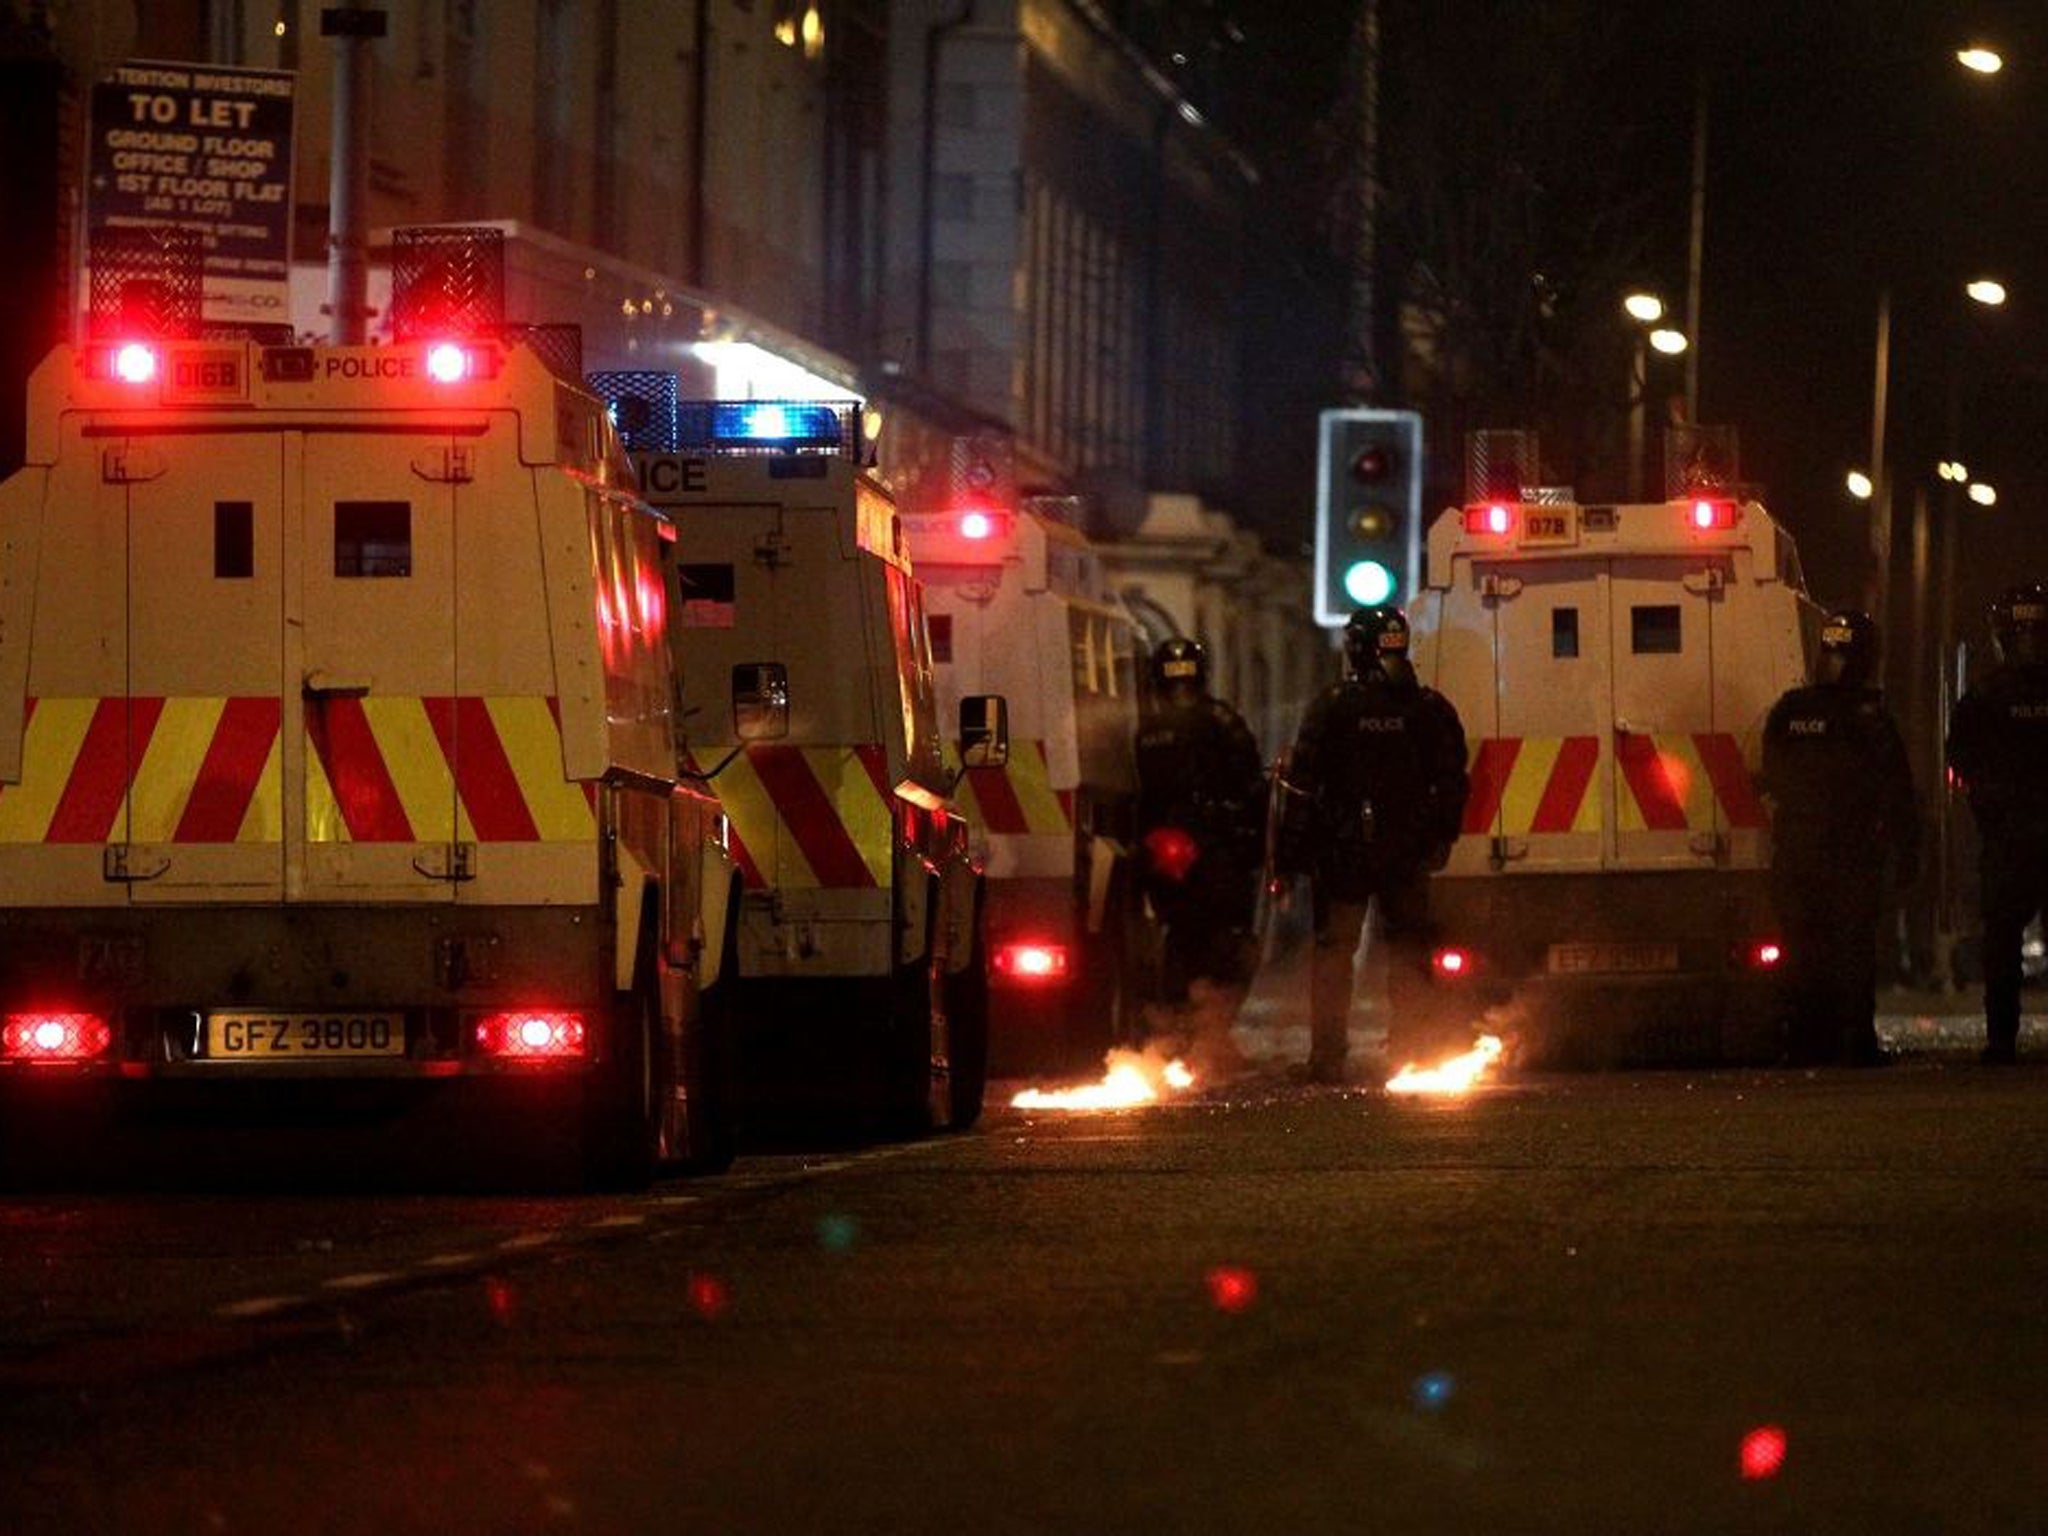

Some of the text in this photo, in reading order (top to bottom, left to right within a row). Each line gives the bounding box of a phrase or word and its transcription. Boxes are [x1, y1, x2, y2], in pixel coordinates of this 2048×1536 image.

[129, 93, 257, 129] TO LET
[107, 129, 274, 159] GROUND FLOOR
[112, 151, 189, 174] OFFICE
[206, 157, 267, 179] SHOP
[158, 176, 228, 198] FLOOR
[234, 181, 285, 203] FLAT
[326, 357, 414, 378] POLICE
[638, 459, 706, 492] ICE
[1358, 715, 1405, 733] POLICE
[224, 1018, 391, 1052] GFZ 3800
